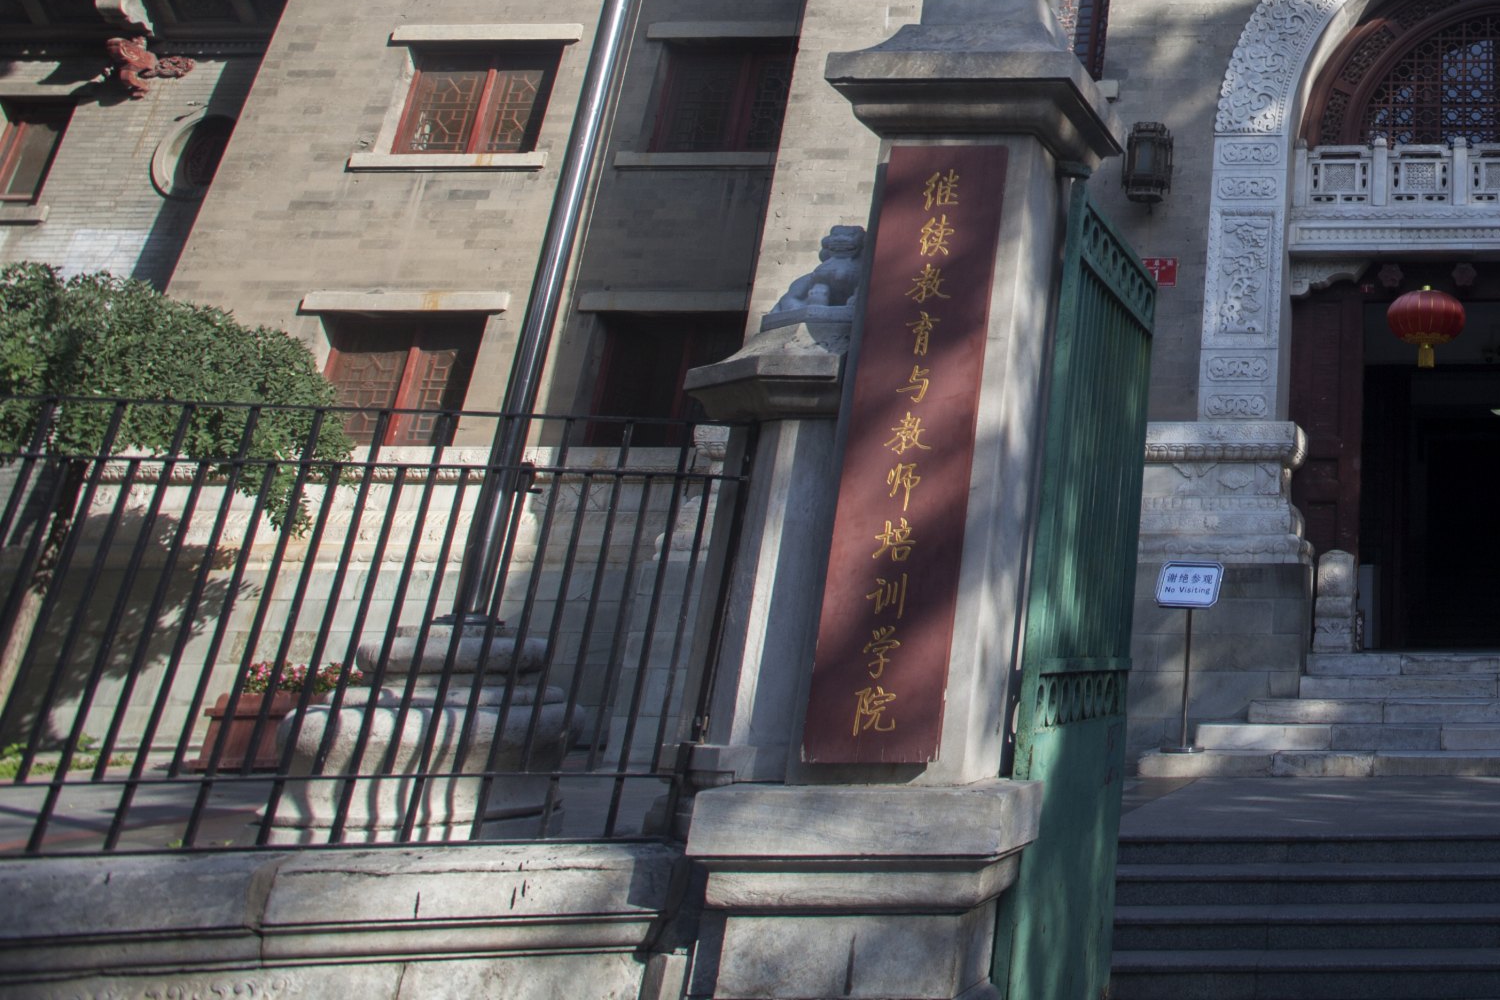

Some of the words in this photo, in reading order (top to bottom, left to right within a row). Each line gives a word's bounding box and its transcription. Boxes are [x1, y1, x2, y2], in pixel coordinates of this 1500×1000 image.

[853, 168, 960, 738] 继续教育与教师培训学院
[1167, 573, 1213, 584] 谢绝参观
[1179, 586, 1211, 595] Visiting
